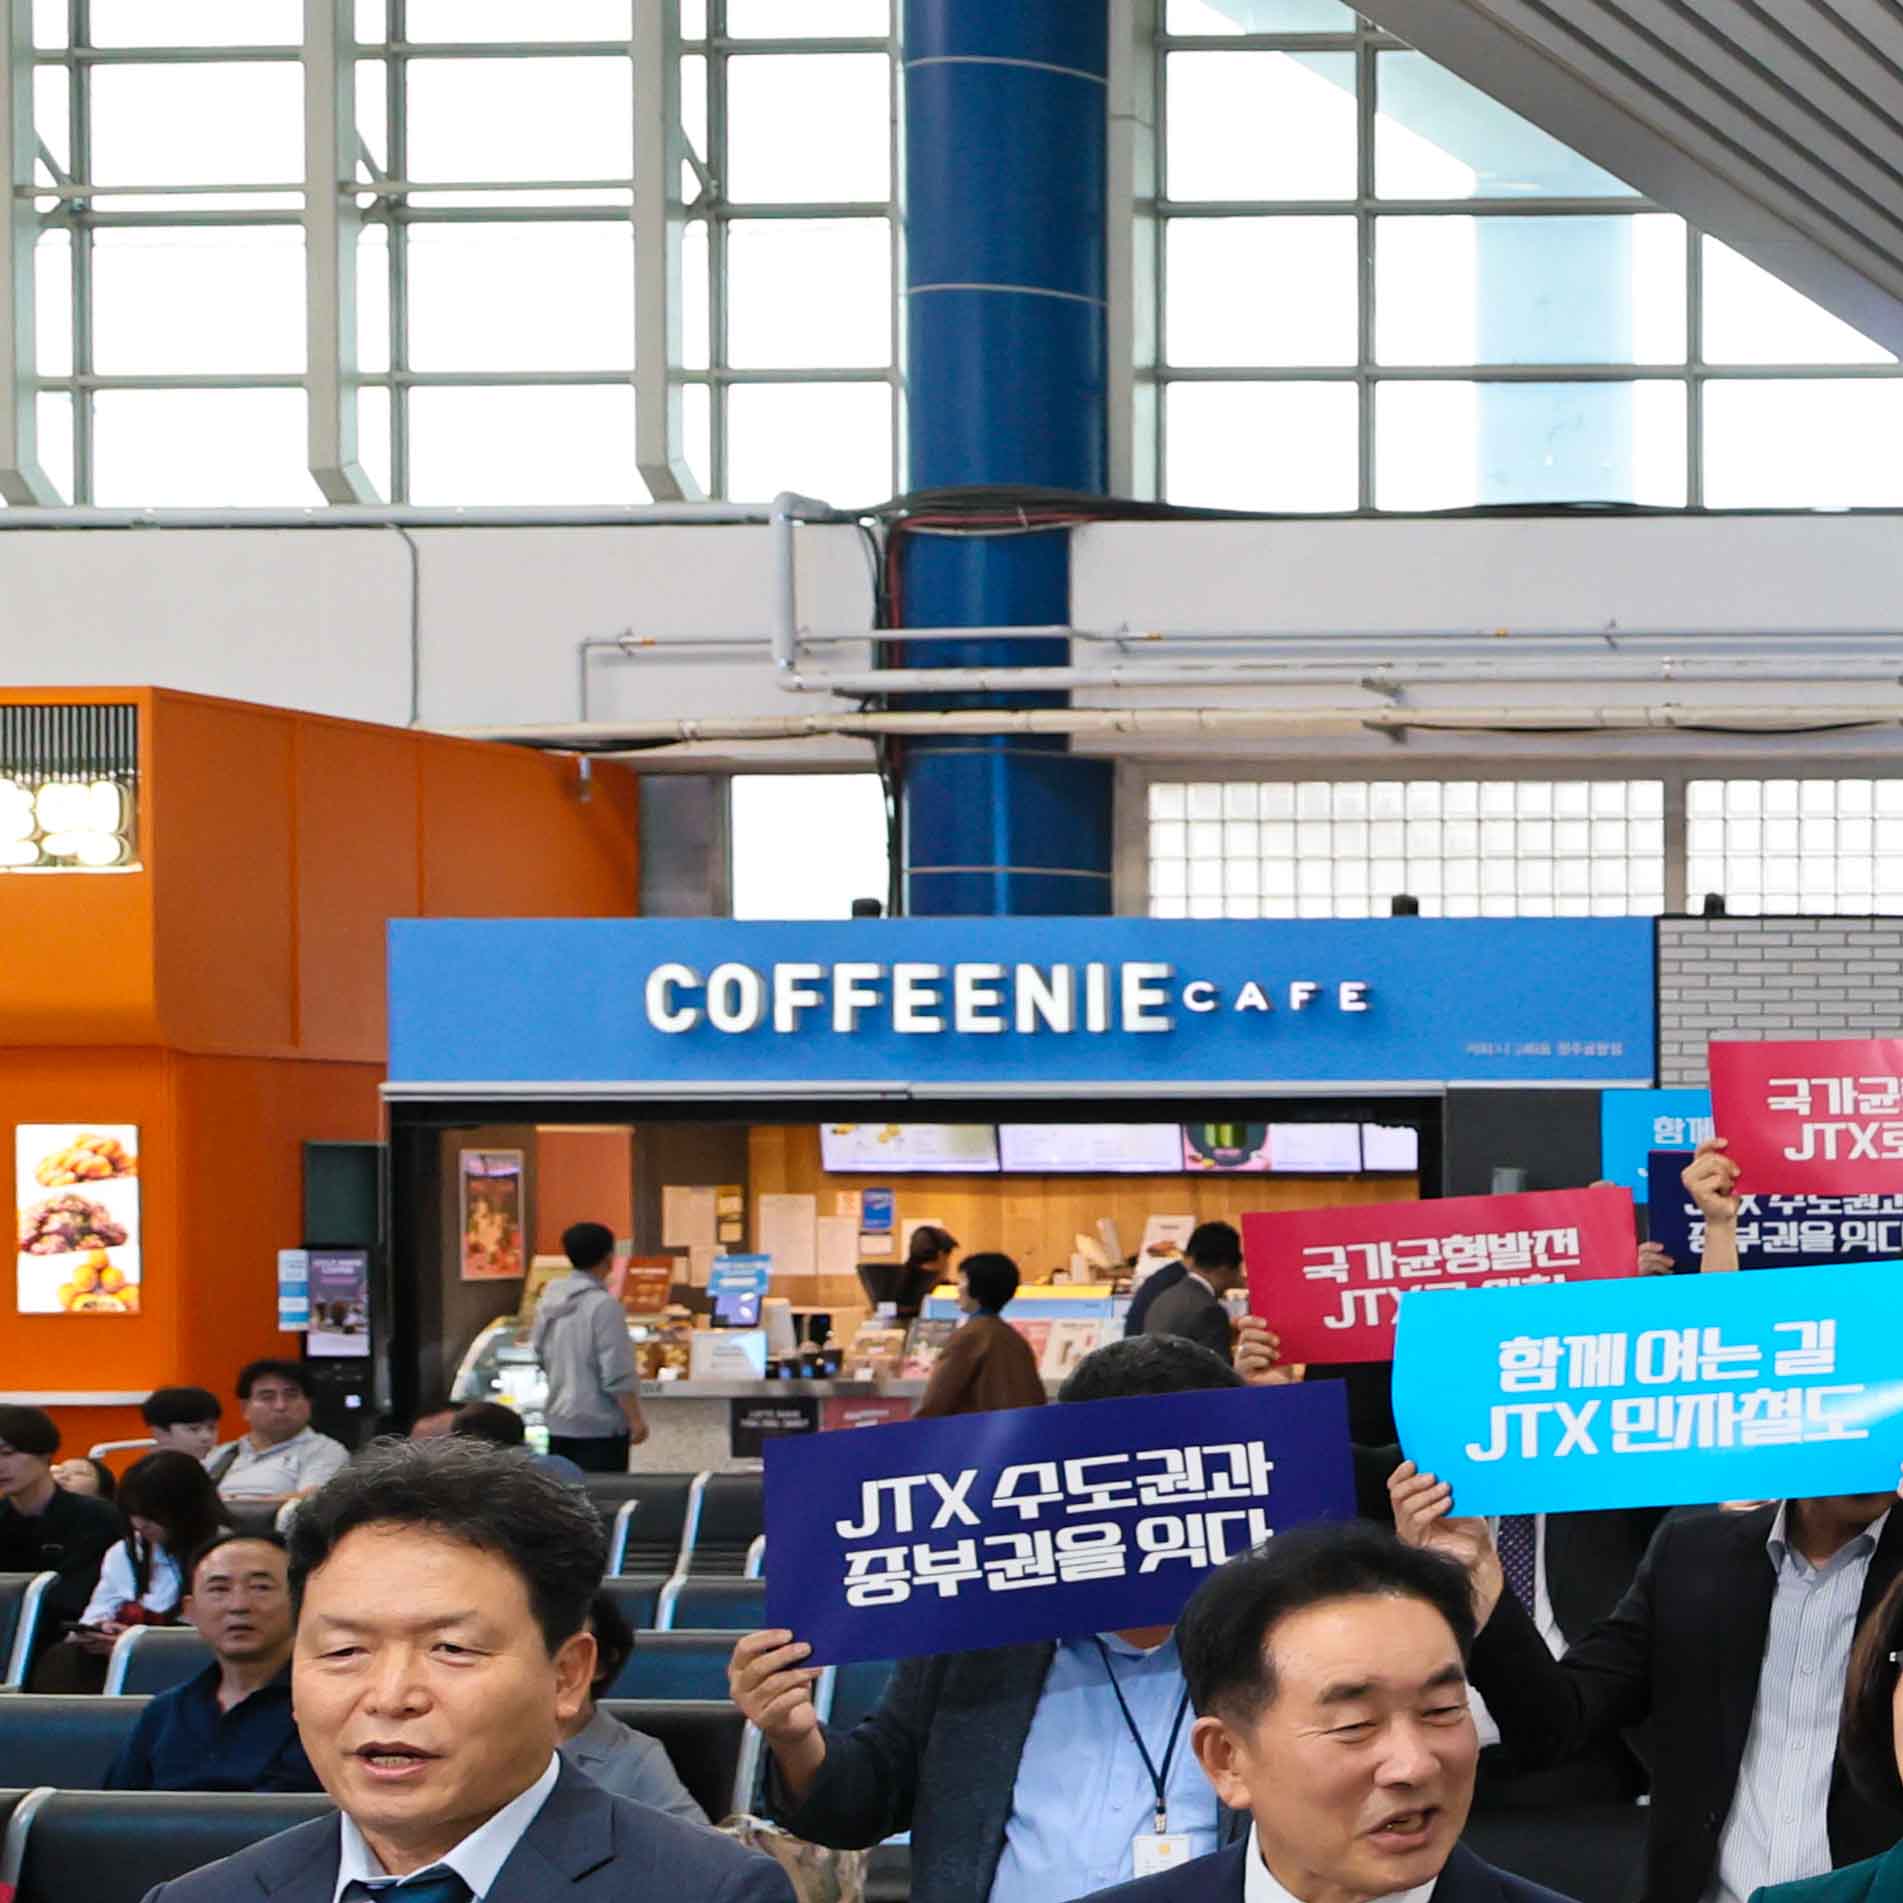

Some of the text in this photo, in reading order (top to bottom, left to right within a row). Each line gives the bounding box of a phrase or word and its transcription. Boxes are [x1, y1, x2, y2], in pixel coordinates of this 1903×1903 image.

[645, 961, 1372, 1034] COFFEENIE CAFE
[1684, 1194, 1762, 1216] JX
[1302, 1227, 1581, 1284] 국가균형발전
[1499, 1318, 1837, 1393] 함께 여는 길
[1465, 1383, 1870, 1463] JTX 민자철도
[835, 1440, 1275, 1540] JTX 수도권과
[843, 1506, 1274, 1609] 중부권을 잇다
